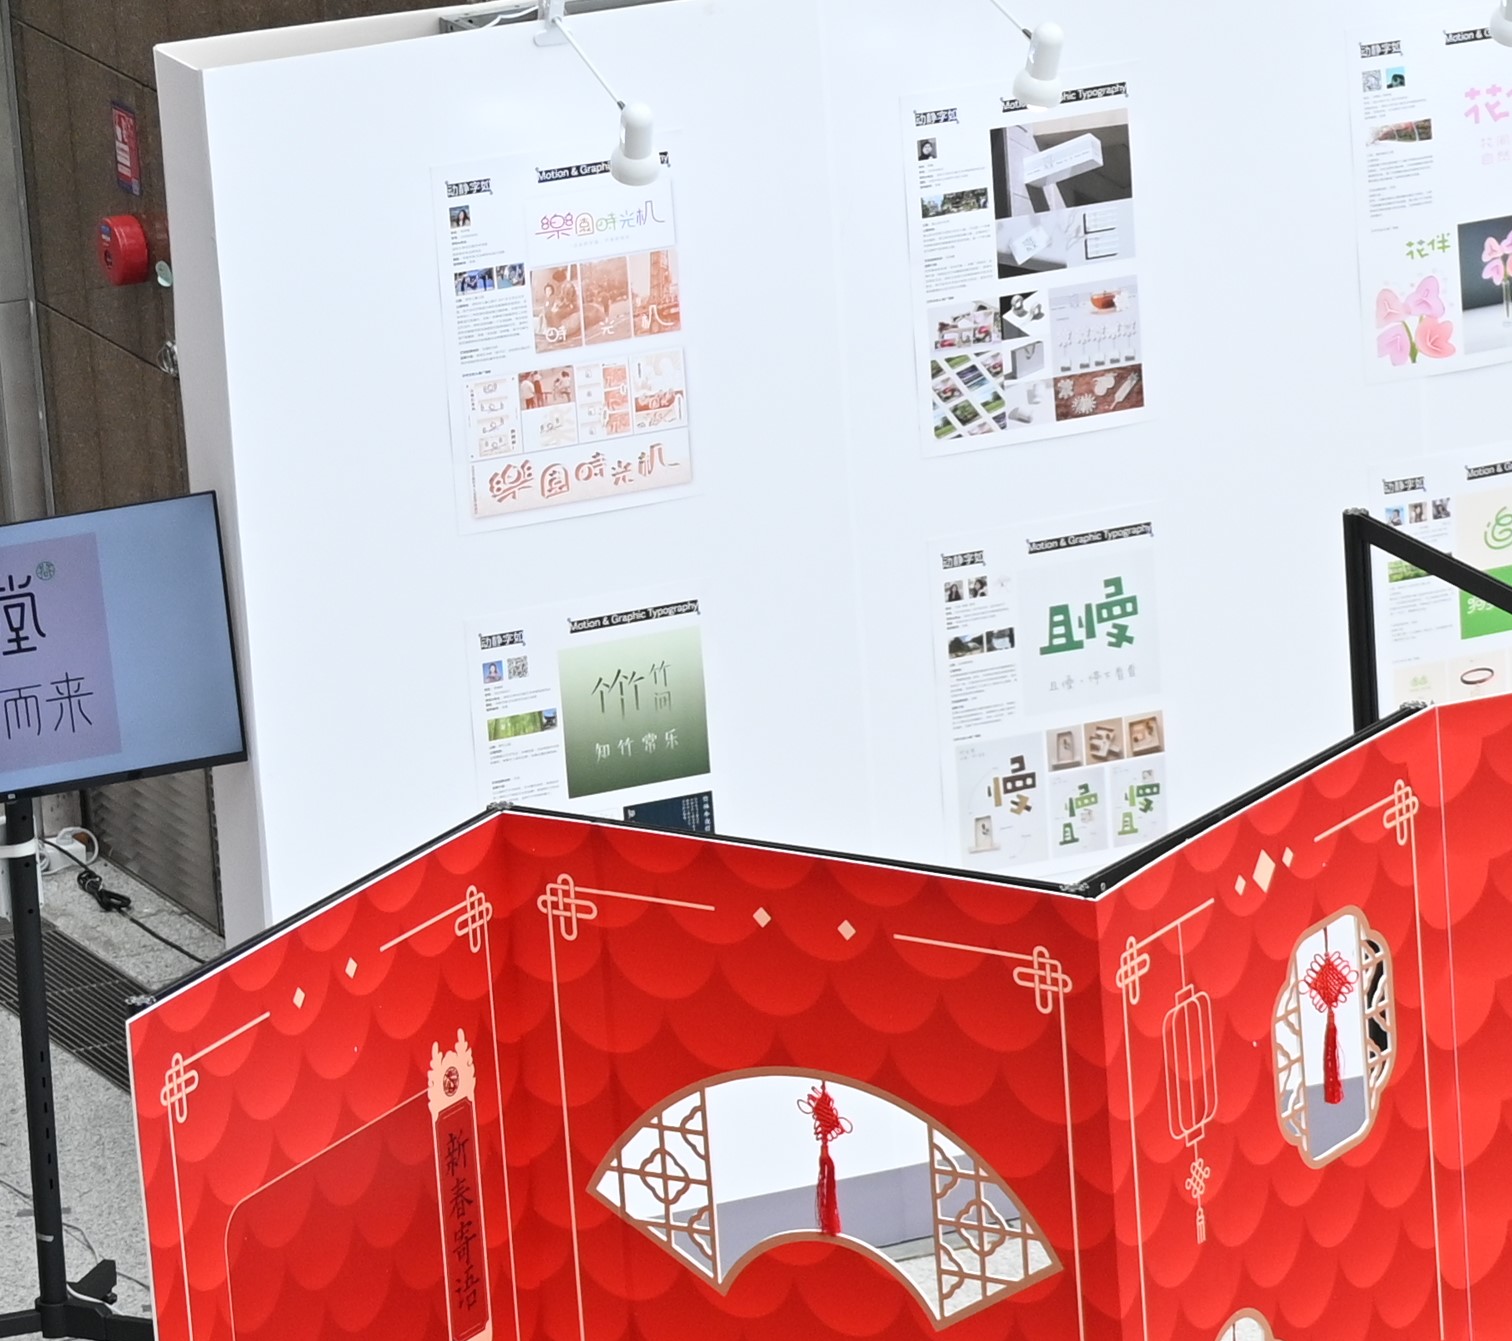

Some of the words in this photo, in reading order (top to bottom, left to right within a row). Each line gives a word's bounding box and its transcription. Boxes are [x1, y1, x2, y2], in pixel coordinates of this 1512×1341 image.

[537, 166, 570, 182] Motion
[1029, 539, 1058, 552] Motion
[1068, 530, 1102, 546] Graphic
[1104, 524, 1152, 541] Typography
[570, 617, 601, 633] Motion
[611, 609, 647, 625] Graphic
[648, 600, 699, 619] Typography
[1039, 576, 1139, 656] 且慢
[0, 672, 94, 739] 而来
[443, 1131, 480, 1311] 新春寄语
